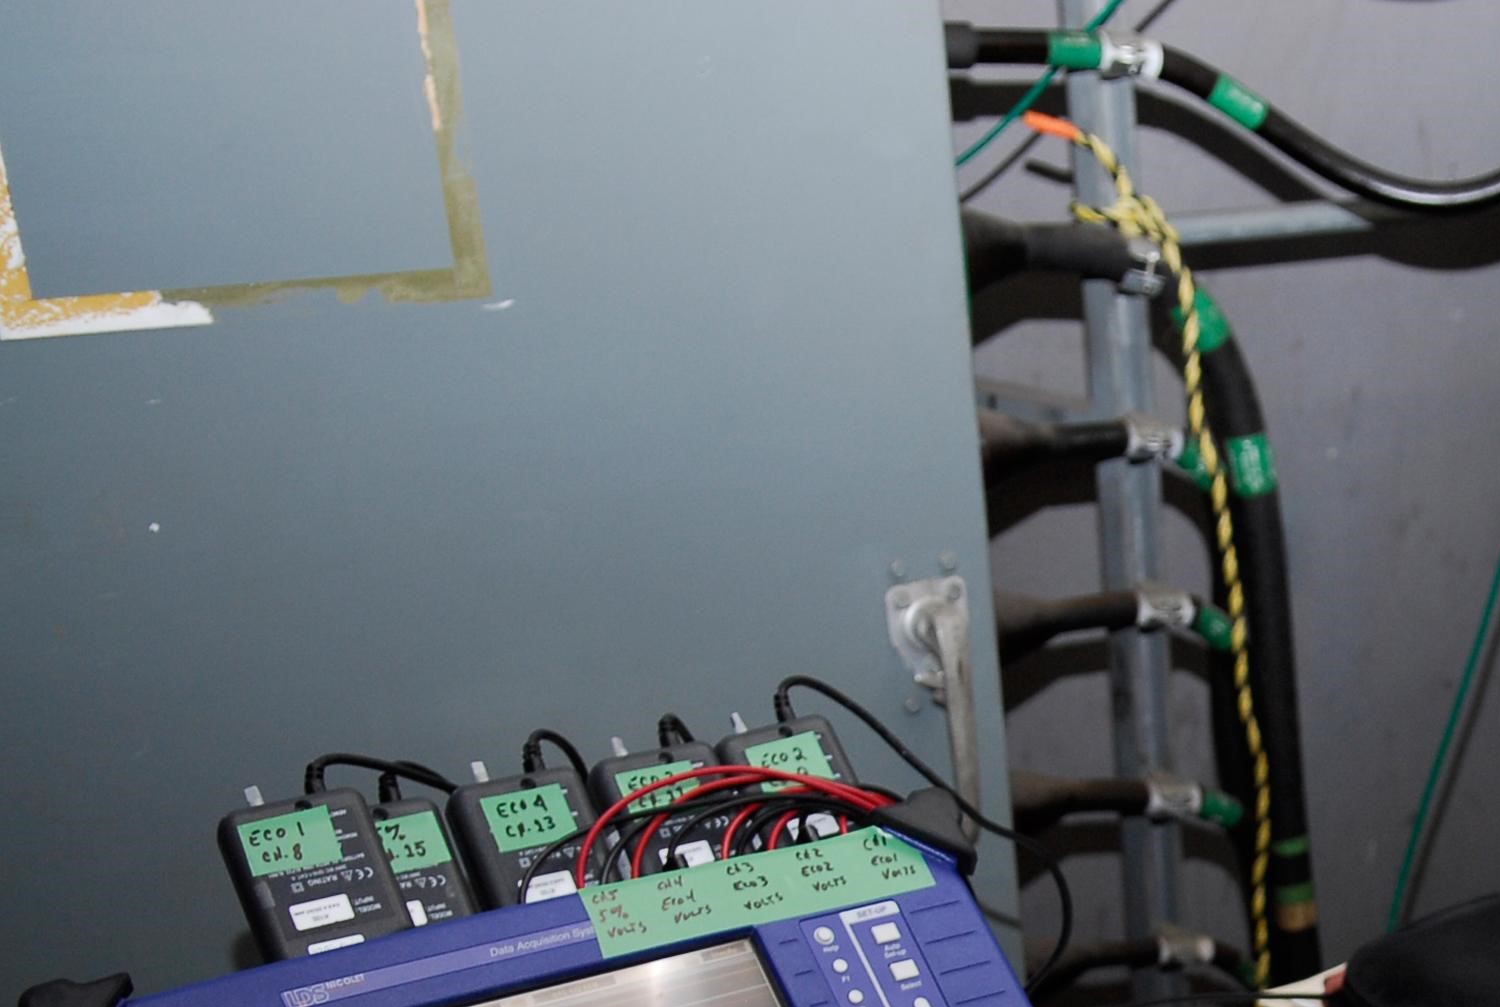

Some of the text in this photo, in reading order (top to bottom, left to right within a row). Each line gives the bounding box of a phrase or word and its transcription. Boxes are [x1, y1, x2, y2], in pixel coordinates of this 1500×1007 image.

[249, 826, 286, 846] ECO
[489, 944, 514, 958] Data
[517, 930, 571, 951] Acquisition
